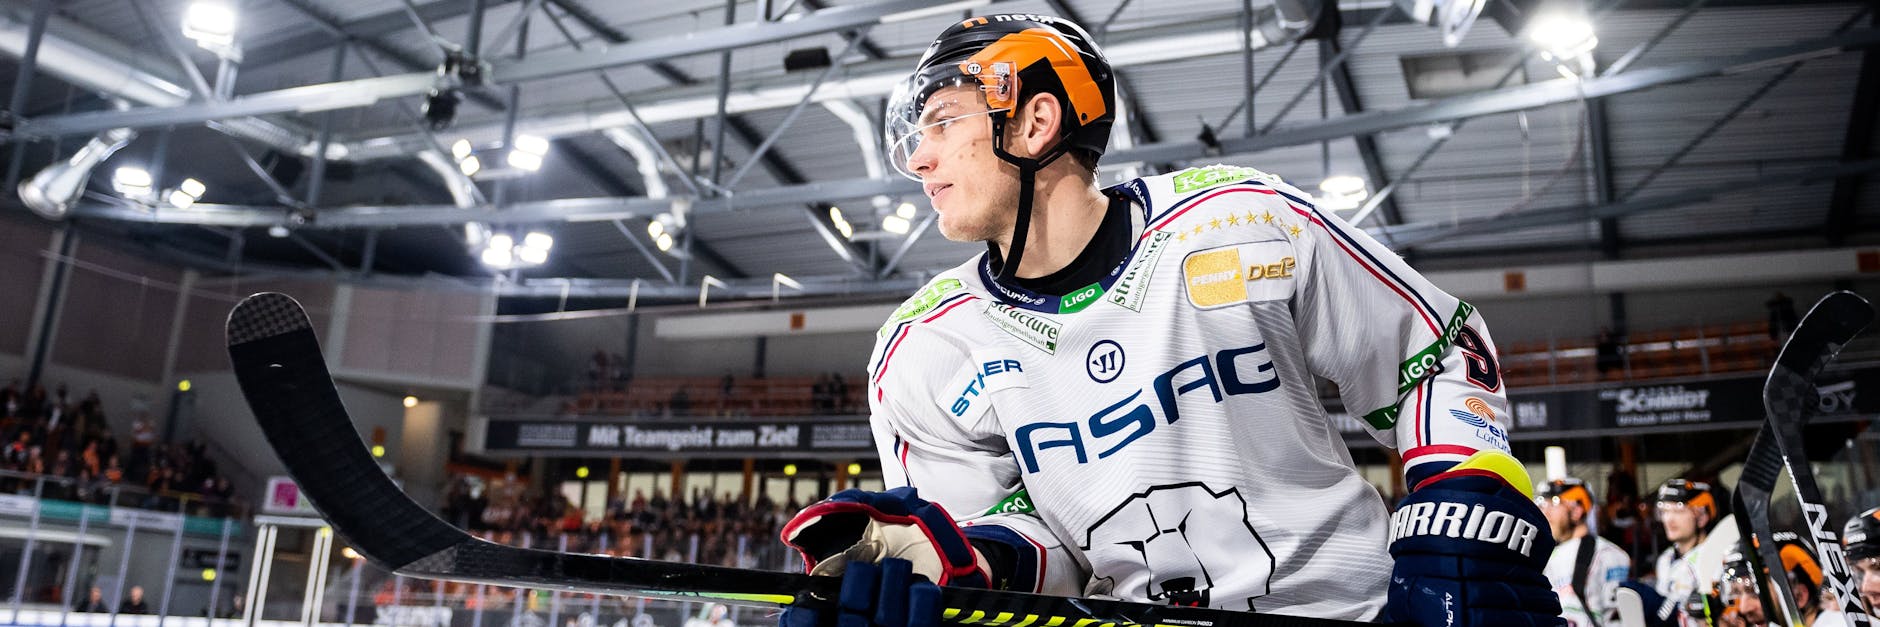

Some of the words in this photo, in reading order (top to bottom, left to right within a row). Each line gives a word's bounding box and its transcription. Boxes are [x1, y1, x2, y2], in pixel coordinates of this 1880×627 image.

[1064, 288, 1096, 308] LIGO
[1014, 341, 1281, 475] ASAG
[588, 425, 619, 446] Mit
[624, 425, 713, 451] Teamgeist
[716, 429, 755, 446] zum
[758, 425, 799, 447] Ziel!
